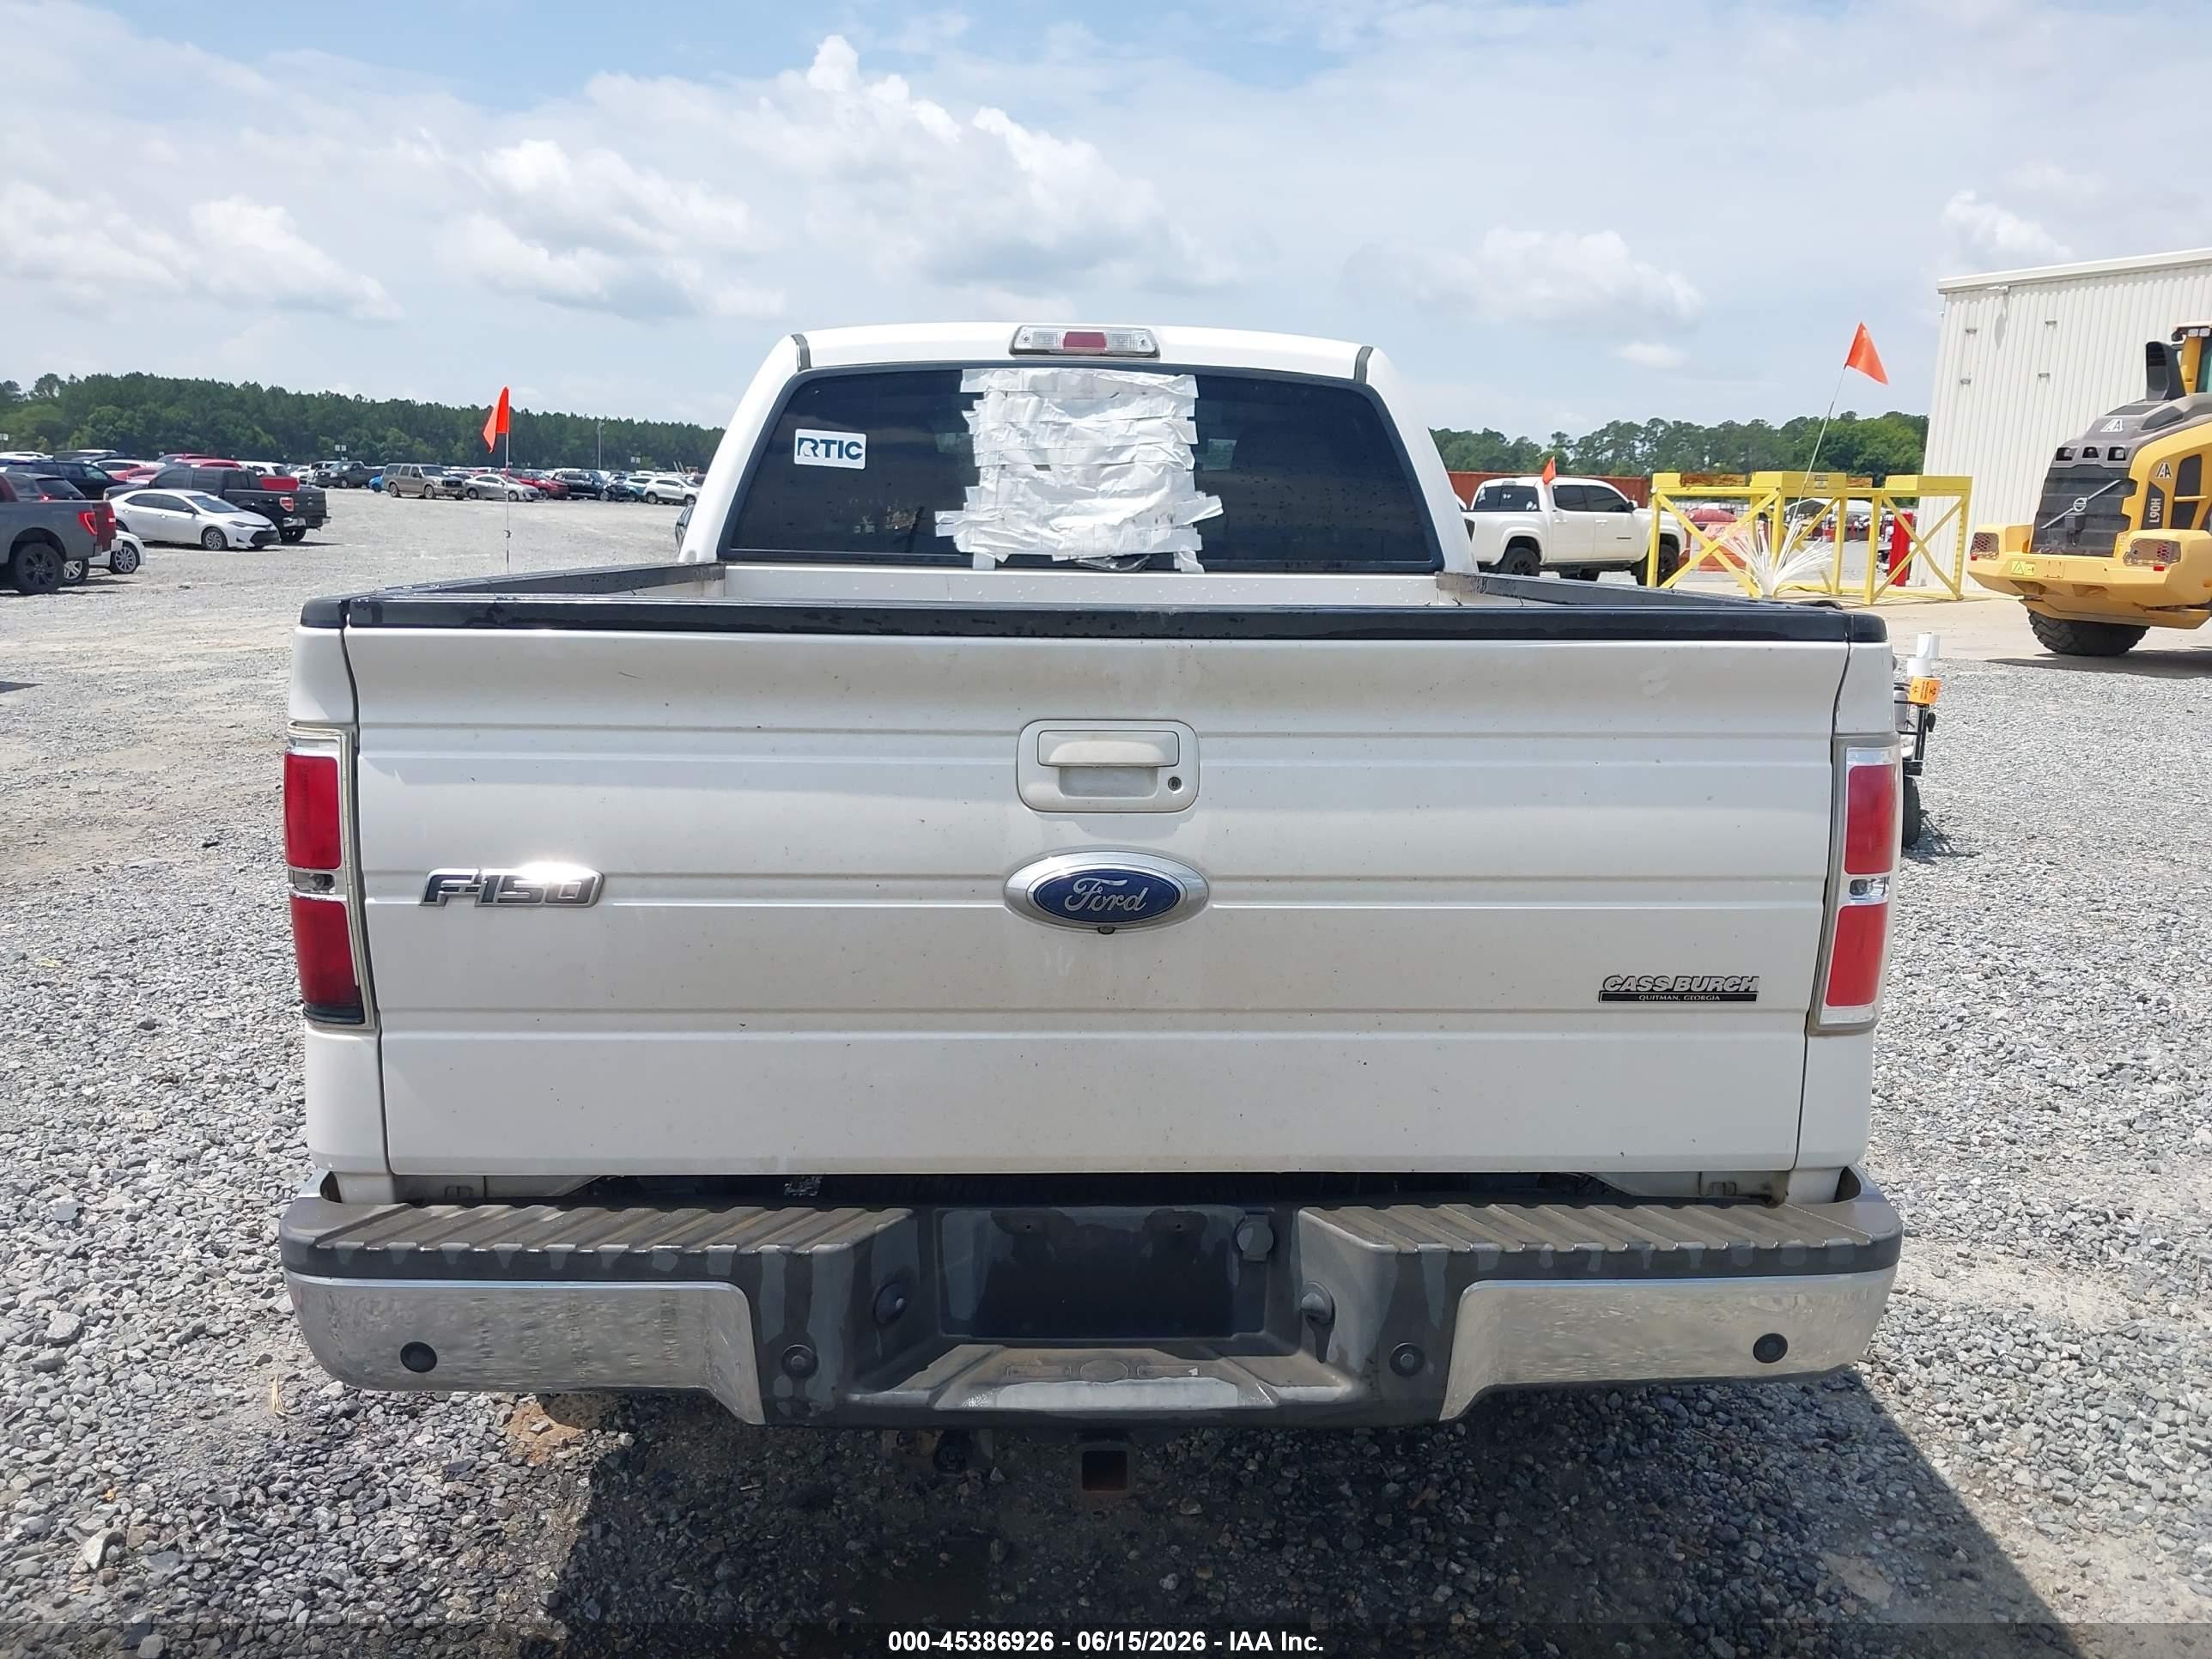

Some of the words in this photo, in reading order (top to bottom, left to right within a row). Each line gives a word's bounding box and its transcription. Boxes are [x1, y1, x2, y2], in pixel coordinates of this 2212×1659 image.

[797, 437, 863, 460] RTIC
[2149, 498, 2161, 522] L90H
[419, 866, 604, 908] F-150
[1064, 877, 1149, 912] Ford
[1602, 975, 1673, 993] CASS
[1673, 975, 1759, 993] BURCH
